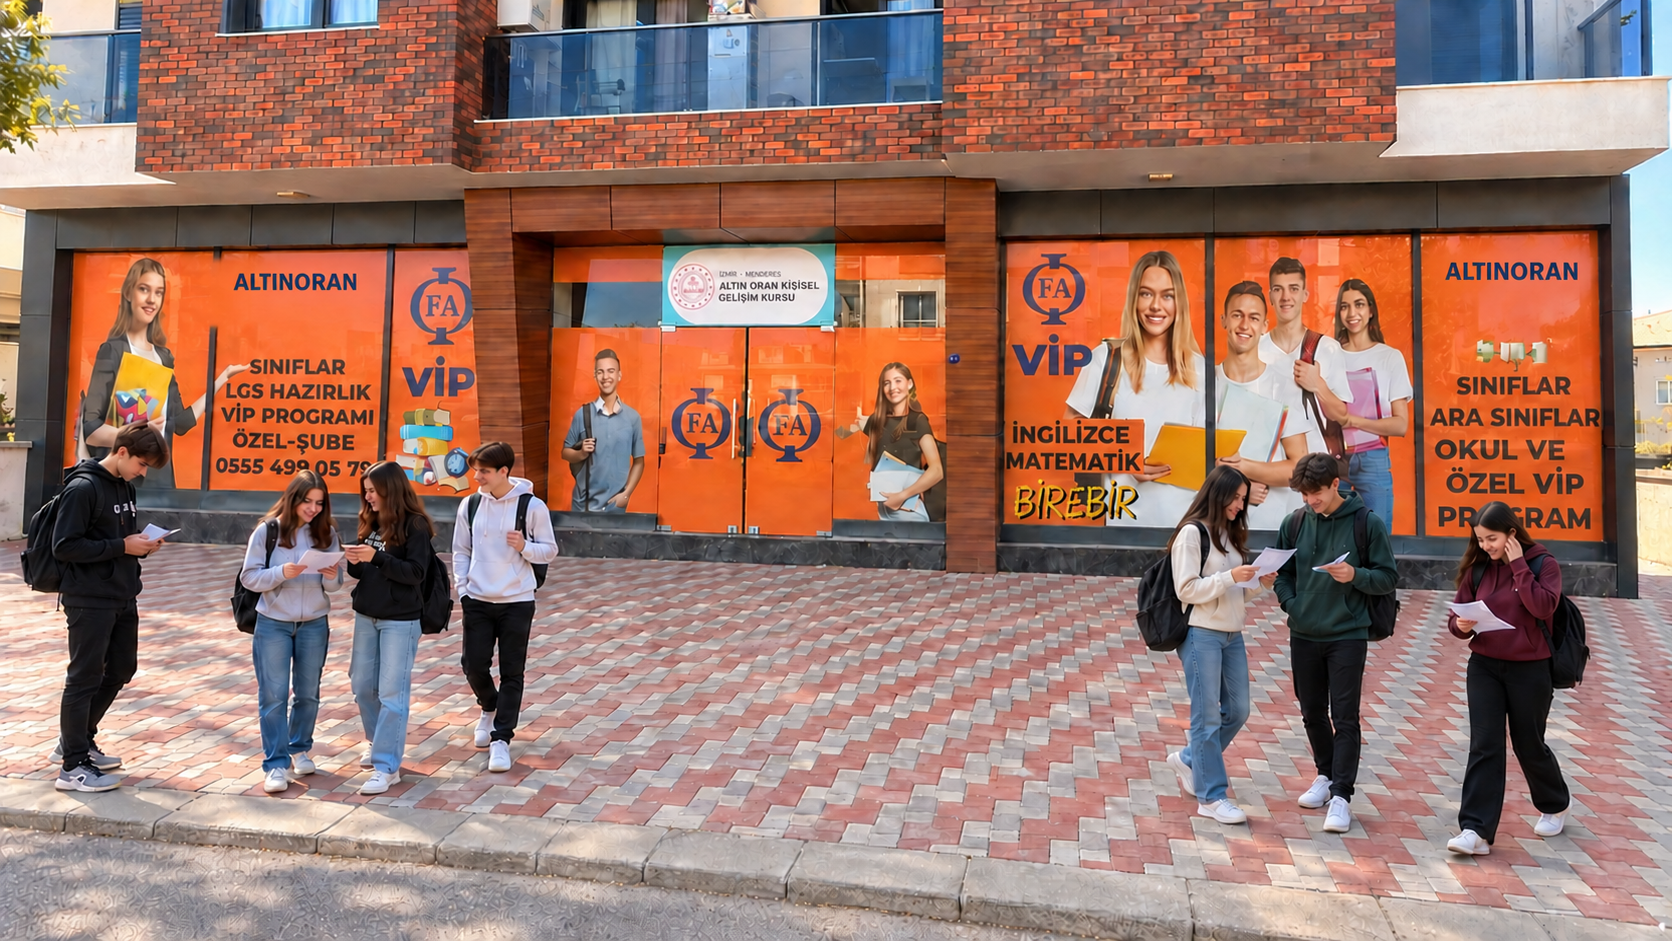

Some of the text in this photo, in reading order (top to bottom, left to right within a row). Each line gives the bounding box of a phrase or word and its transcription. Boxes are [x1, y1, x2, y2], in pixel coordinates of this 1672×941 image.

[233, 272, 358, 291] ALTINORAN
[745, 270, 782, 278] MENDERES
[1445, 261, 1579, 281] ALTINORAN
[719, 279, 820, 291] ALTIN ORAN KİŞİSEL
[1038, 277, 1073, 299] FA
[425, 294, 460, 317] FA
[718, 291, 796, 304] GELİŞİM KURSU
[1011, 333, 1093, 376] VİP
[249, 358, 346, 375] SINIFLAR
[402, 355, 476, 398] VİP
[225, 382, 372, 401] LGS HAZIRLIK
[1456, 376, 1571, 396] SINIFLAR
[220, 402, 374, 426] VİP PROGRAMI
[685, 412, 719, 434] FA
[773, 414, 808, 436] FA
[1430, 407, 1600, 428] ARA SINIFLAR
[232, 428, 355, 456] ÖZEL-ŞUBE
[1012, 420, 1130, 444] İNGİLİZCE
[1006, 448, 1141, 472] MATEMATİK
[1434, 439, 1566, 461] OKUL VE
[215, 457, 264, 475] 0555
[315, 460, 341, 477] 05
[1446, 465, 1585, 496] ÖZEL VİP
[1014, 478, 1139, 521] BİREBİR
